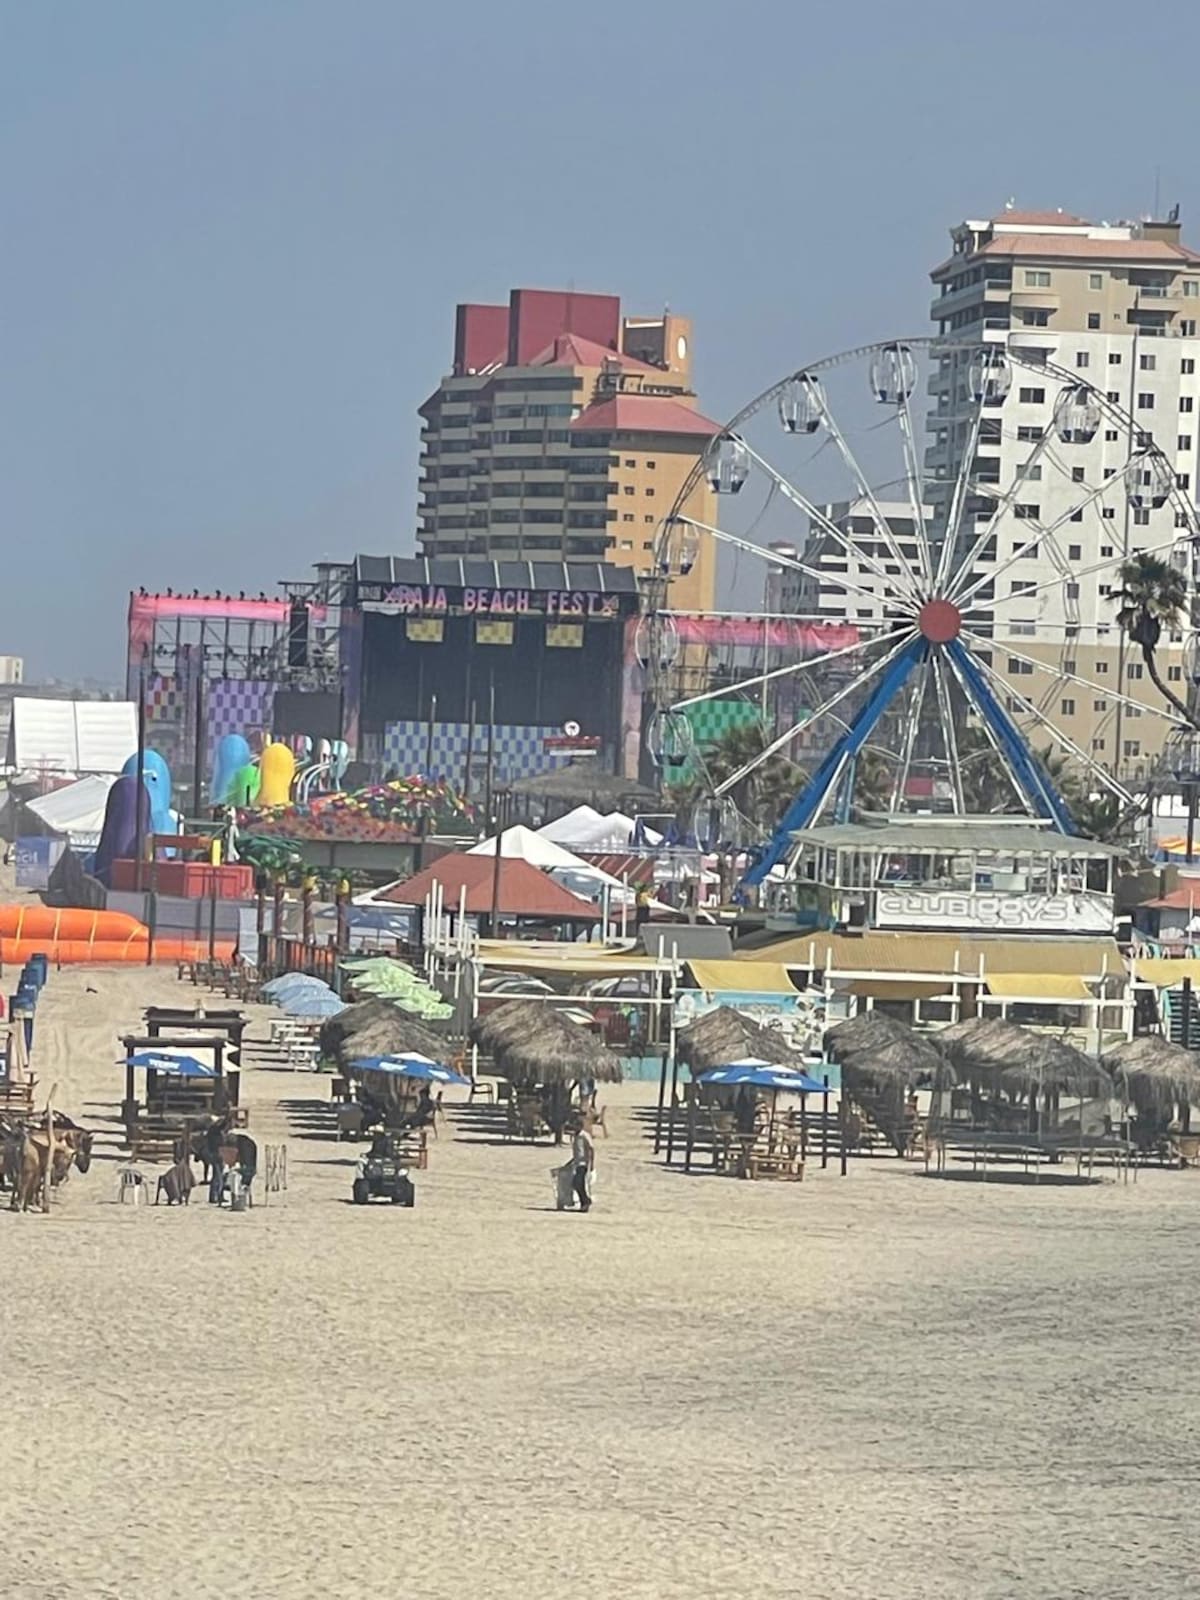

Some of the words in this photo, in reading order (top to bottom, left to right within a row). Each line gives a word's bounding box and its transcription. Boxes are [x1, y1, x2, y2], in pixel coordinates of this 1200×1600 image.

[398, 584, 447, 611] BAJA
[463, 588, 528, 613] BEACH
[546, 590, 599, 615] FEST
